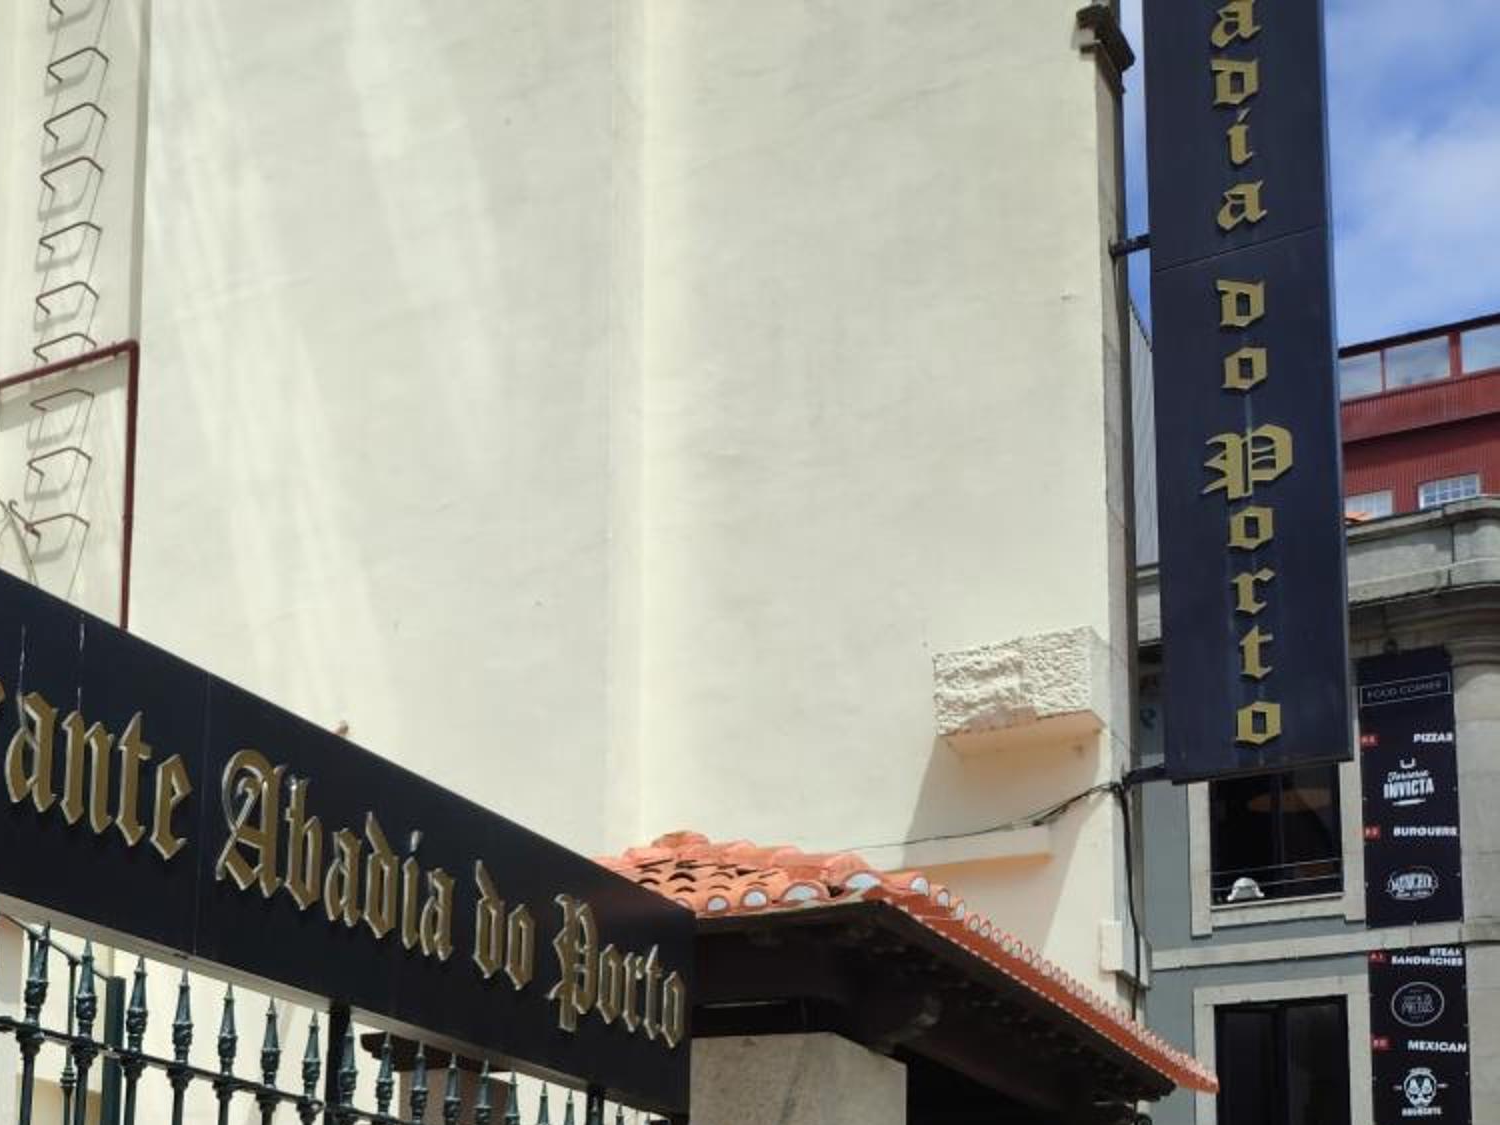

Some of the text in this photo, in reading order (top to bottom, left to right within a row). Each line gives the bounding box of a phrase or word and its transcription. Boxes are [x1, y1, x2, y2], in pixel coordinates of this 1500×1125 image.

[1216, 279, 1268, 391] do
[1200, 423, 1293, 745] Porto
[1413, 732, 1453, 743] PIZZAS
[1383, 778, 1435, 799] INVICTA
[215, 748, 455, 961] Abadia
[473, 859, 536, 991] do
[548, 893, 687, 1049] Porto
[1391, 956, 1463, 966] SANDWICHES
[1407, 1040, 1467, 1052] MEXICAN
